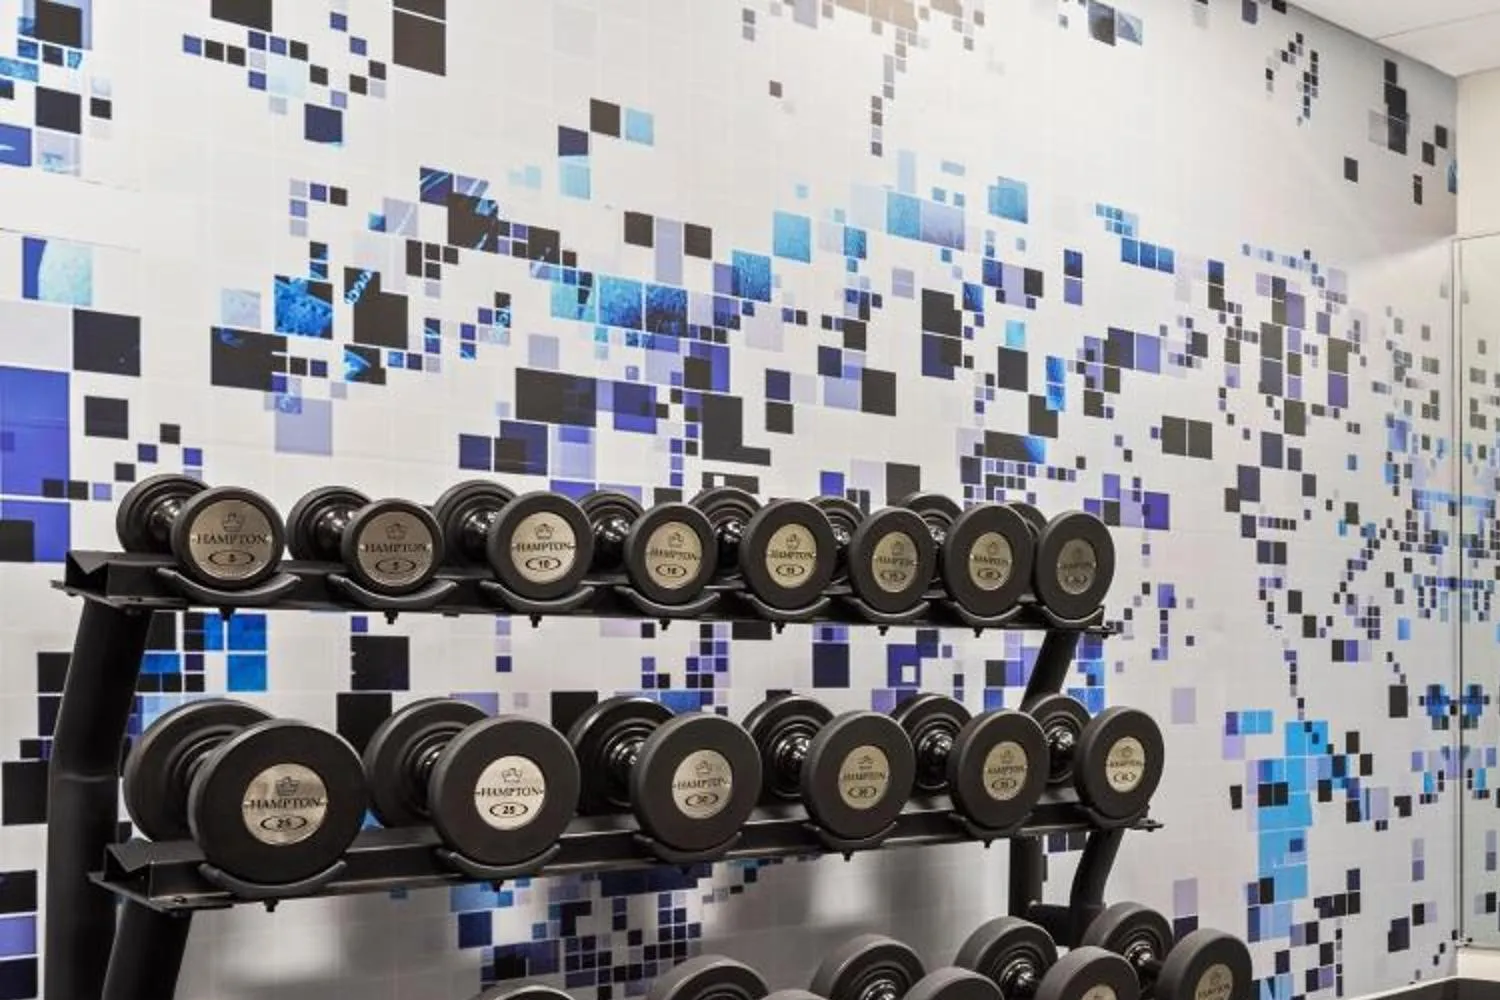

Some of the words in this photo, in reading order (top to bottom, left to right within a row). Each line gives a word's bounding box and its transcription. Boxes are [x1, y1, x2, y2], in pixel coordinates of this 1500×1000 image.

[197, 533, 266, 545] HAMPTON
[365, 543, 427, 553] HAMPTON
[517, 543, 569, 552] HAMPTON
[678, 778, 726, 790] HAMPTON
[481, 787, 539, 797] HAMPTON
[251, 798, 321, 809] HAMPTON
[502, 806, 515, 815] 25
